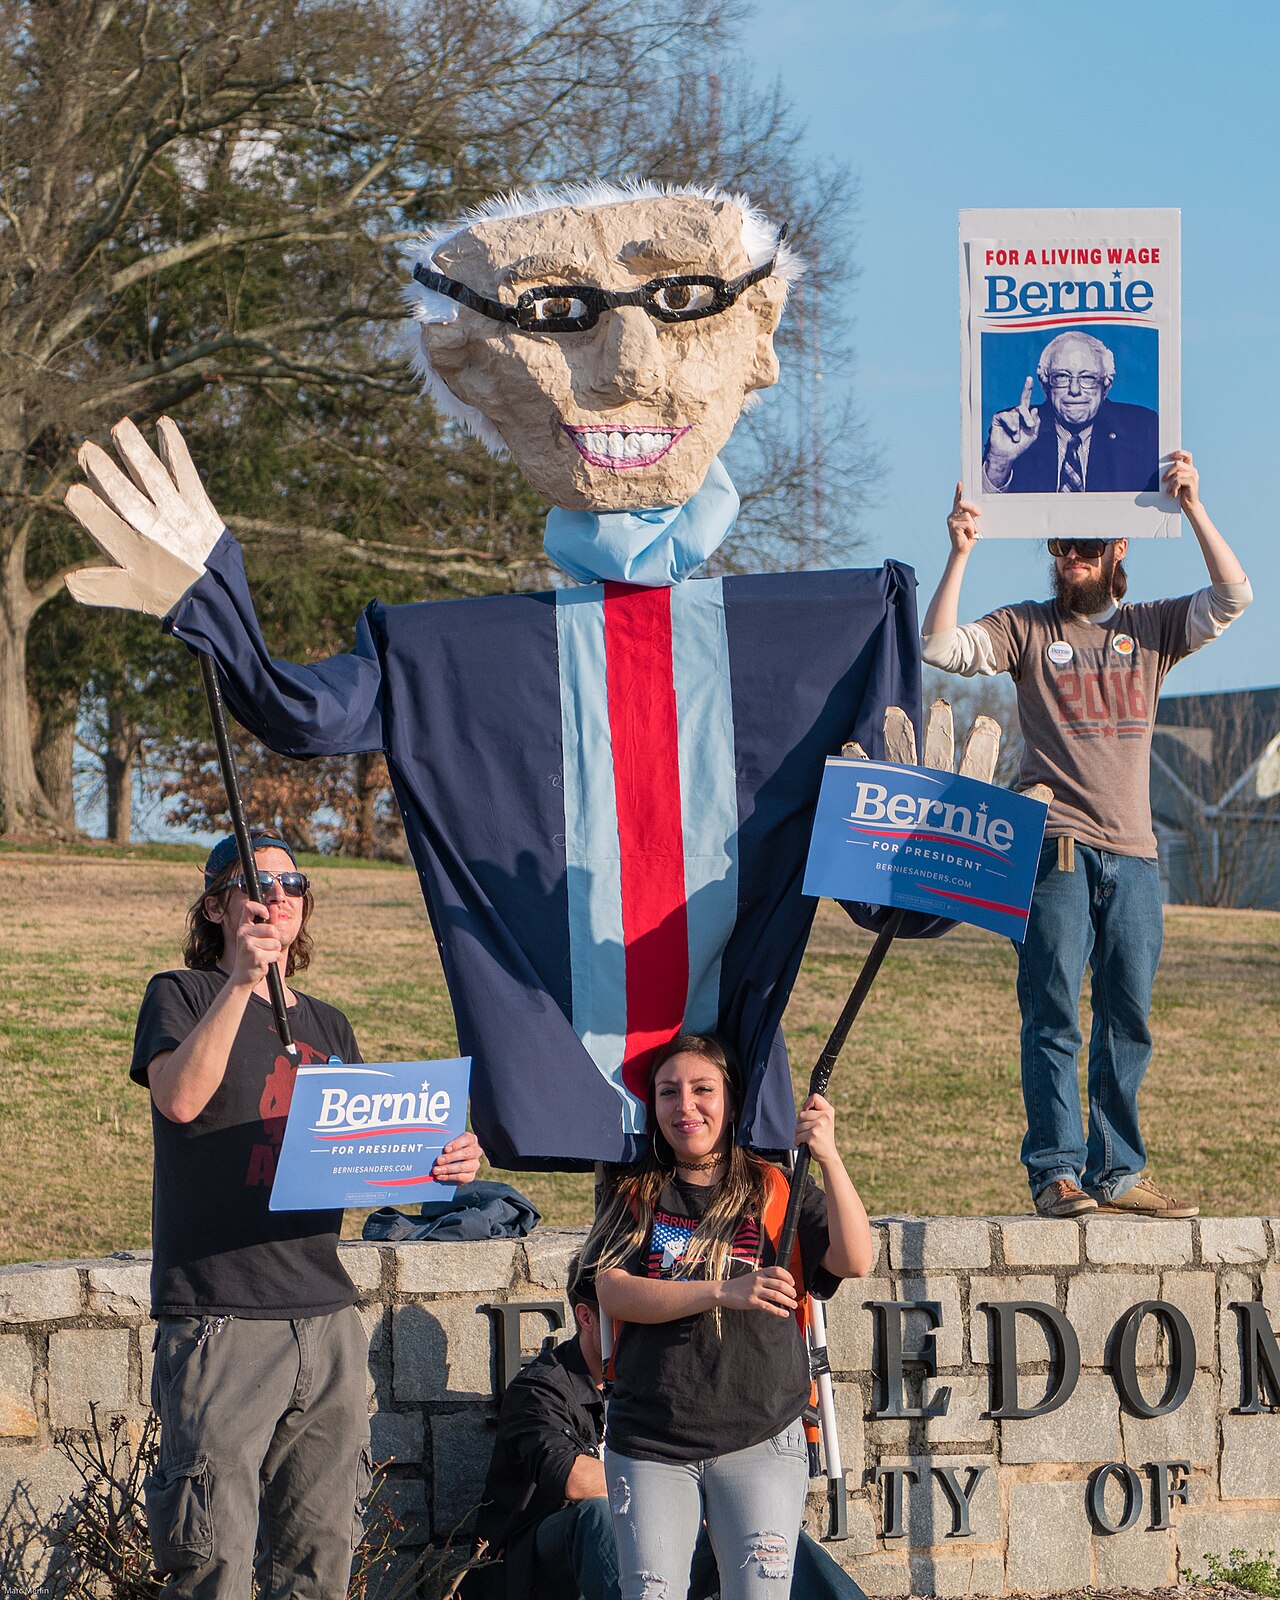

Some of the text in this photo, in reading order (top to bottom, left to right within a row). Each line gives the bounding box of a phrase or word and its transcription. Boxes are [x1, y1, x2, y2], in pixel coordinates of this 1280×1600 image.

[985, 247, 1160, 266] FOR A LIVING WAGE
[983, 268, 1154, 315] Bernie
[1055, 669, 1148, 722] 2016
[850, 781, 1015, 851] Bernie
[872, 840, 982, 872] FOR PRESIDENT
[875, 862, 972, 889] BERNIESANDERS.COM
[315, 1079, 451, 1127] Bernie
[331, 1143, 424, 1155] FOR PRESIDENT
[332, 1164, 413, 1174] BERNIESANDERS.COM
[655, 1211, 700, 1231] BERNIE
[826, 1459, 1191, 1541] ITY OF
